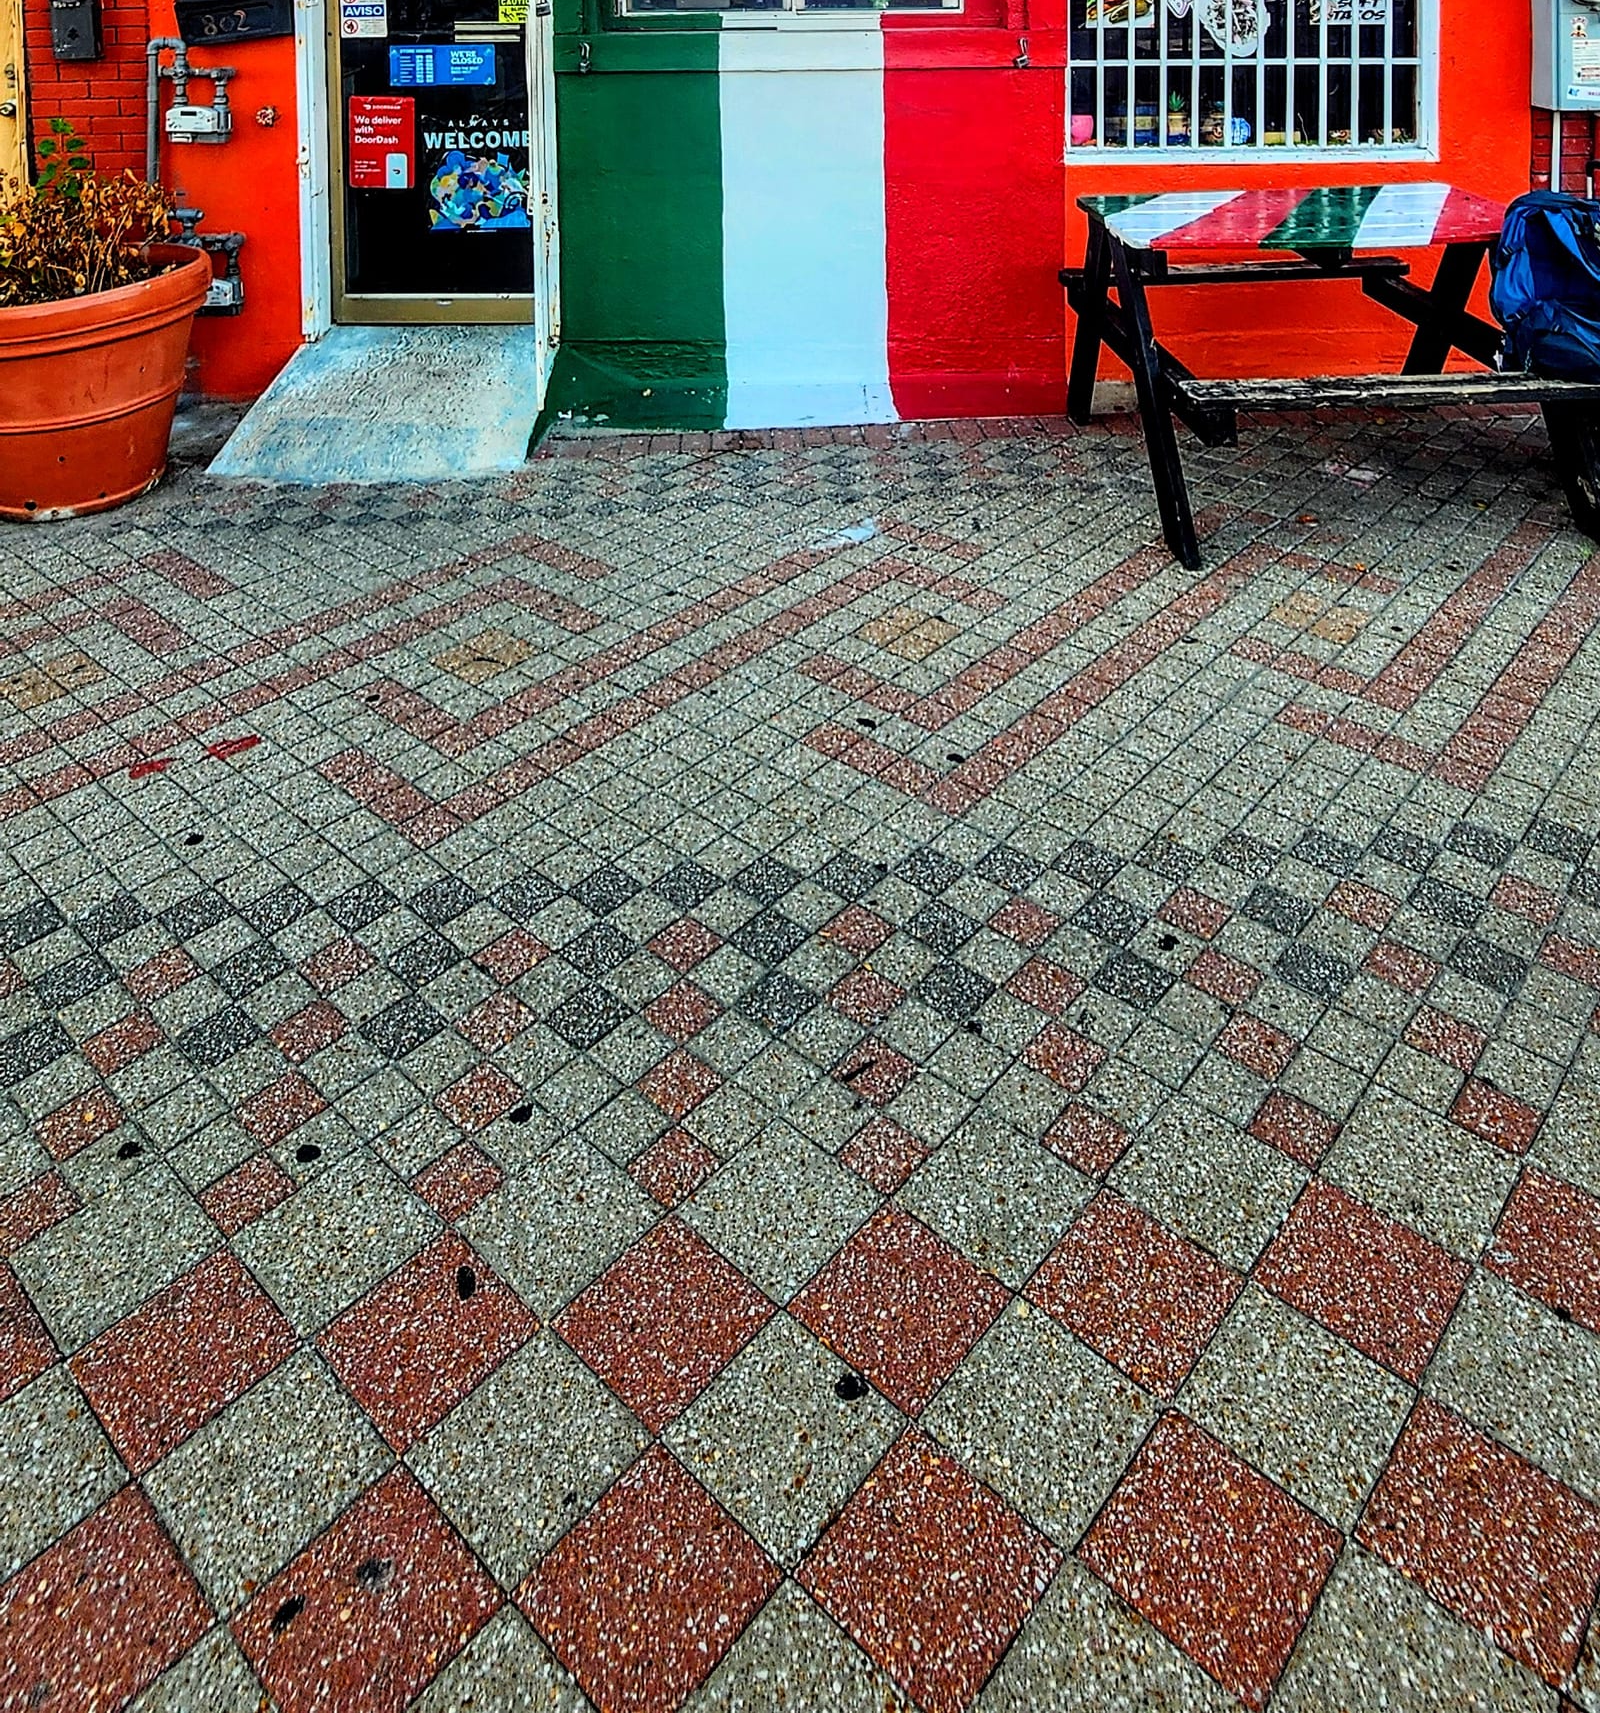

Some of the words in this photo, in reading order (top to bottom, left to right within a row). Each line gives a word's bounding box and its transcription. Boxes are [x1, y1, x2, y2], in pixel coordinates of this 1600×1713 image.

[345, 6, 383, 16] AVISO
[1333, 10, 1386, 20] TAOS
[202, 9, 250, 36] 802
[354, 115, 370, 124] We
[371, 115, 402, 124] deliver
[448, 119, 509, 127] ALWAYS
[354, 126, 374, 134] with
[354, 136, 399, 144] DoorDash
[423, 131, 529, 149] WELCOME
